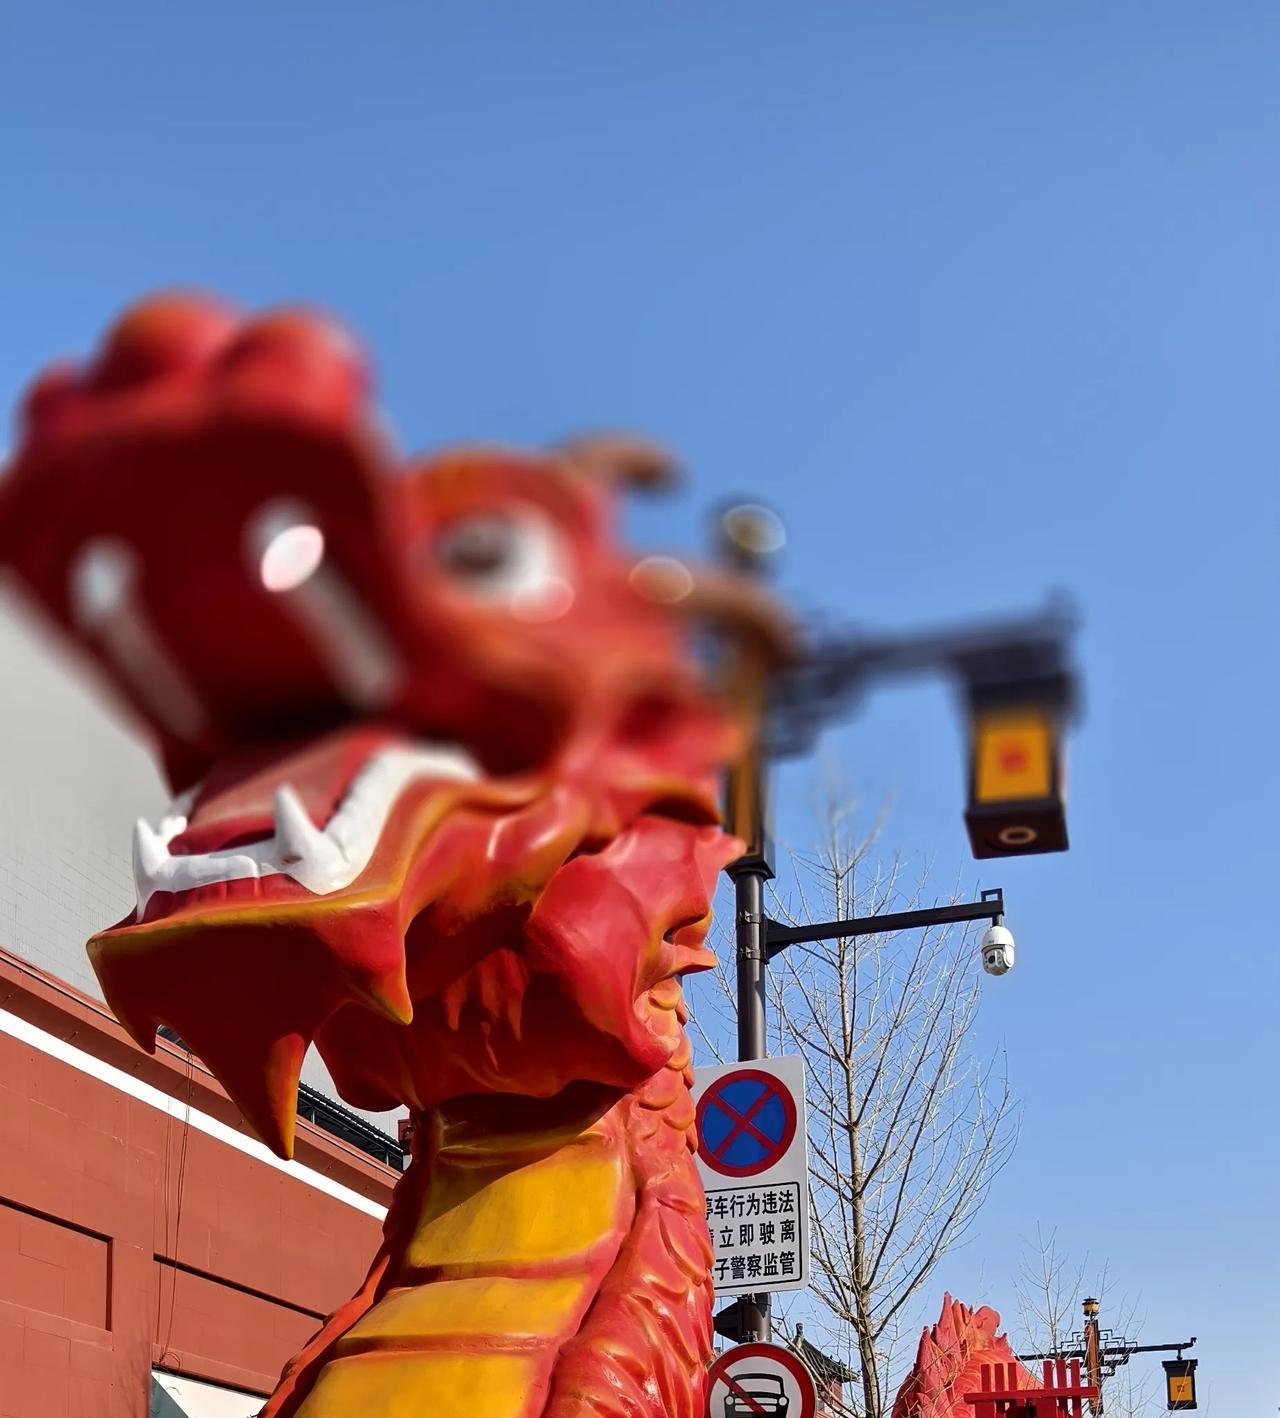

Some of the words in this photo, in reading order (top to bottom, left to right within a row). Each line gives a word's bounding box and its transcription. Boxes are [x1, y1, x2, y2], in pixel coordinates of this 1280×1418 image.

[709, 1219, 795, 1248] 立即驶离
[711, 1251, 795, 1281] 子警察监管
